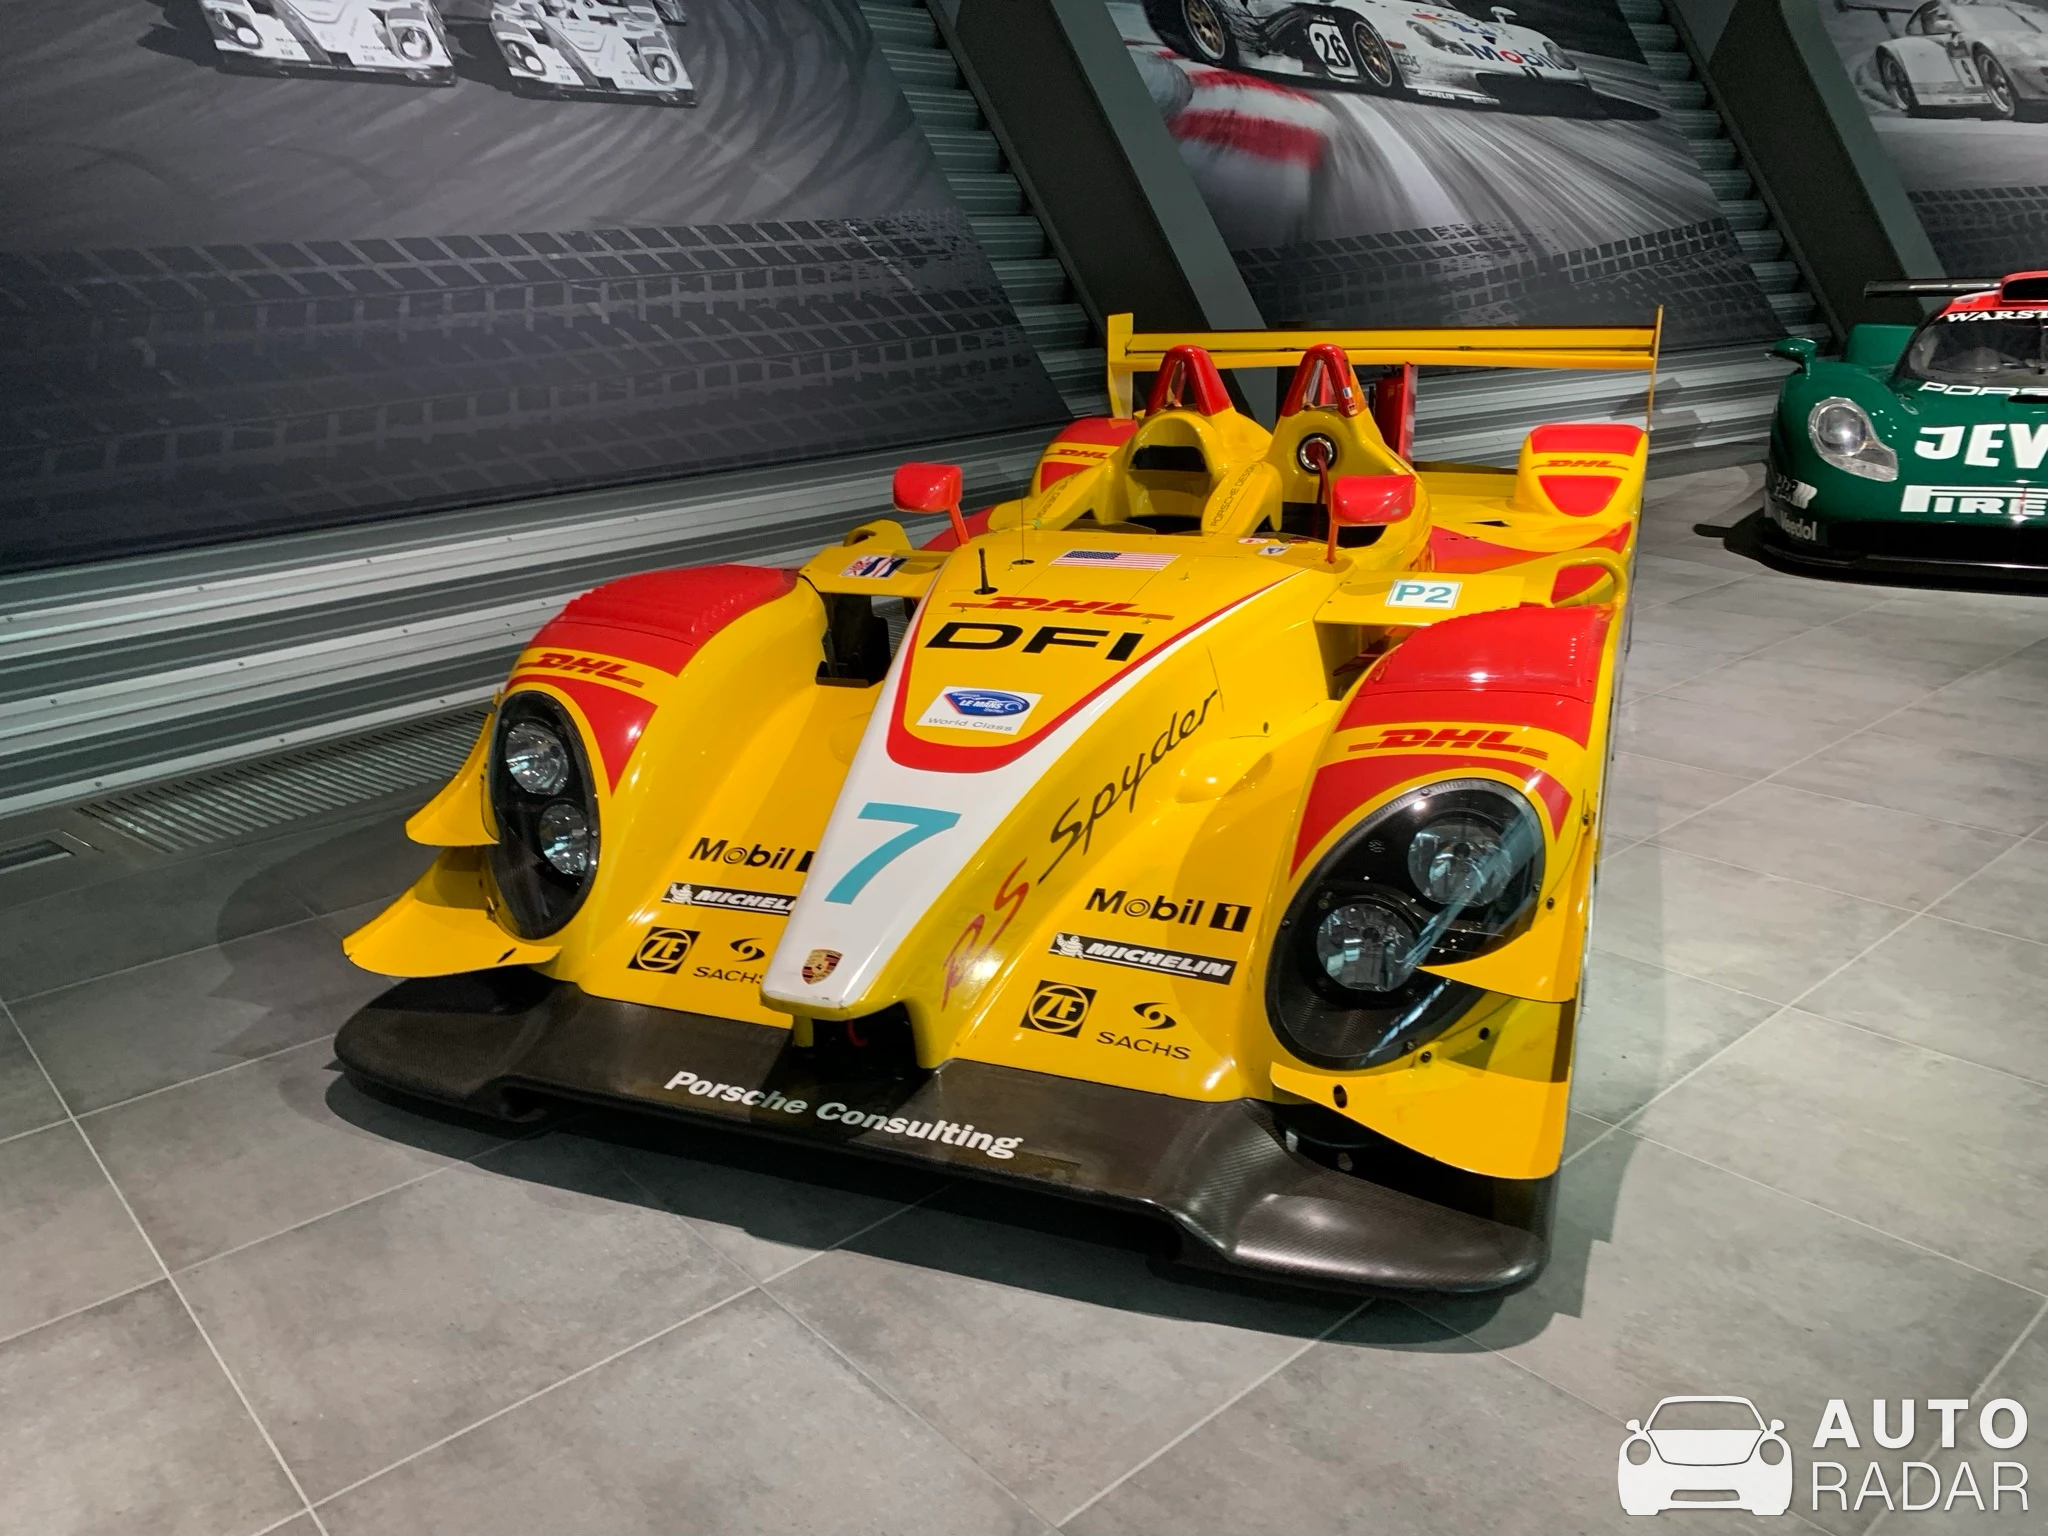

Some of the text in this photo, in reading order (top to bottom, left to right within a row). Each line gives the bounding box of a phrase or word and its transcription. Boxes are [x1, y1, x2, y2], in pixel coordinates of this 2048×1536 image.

[1314, 31, 1350, 67] 26
[1465, 43, 1562, 71] Mobil
[1059, 448, 1108, 460] DHL
[1914, 423, 2048, 469] JEV
[1210, 487, 1240, 527] PORSCHE
[982, 596, 1142, 617] DHL
[1395, 584, 1453, 604] P2
[924, 622, 1145, 662] DFI
[530, 652, 633, 681] DHL
[973, 700, 1003, 708] MANS
[928, 717, 1013, 732] World Class
[1375, 729, 1524, 754] DHL
[1037, 689, 1218, 886] Spyder
[688, 837, 795, 870] Mobil
[824, 802, 962, 905] 7
[1084, 888, 1205, 925] Mobil
[1086, 942, 1232, 977] MICHELIN
[1096, 1031, 1192, 1060] SACHS
[664, 1070, 1024, 1160] Porsche Consulting
